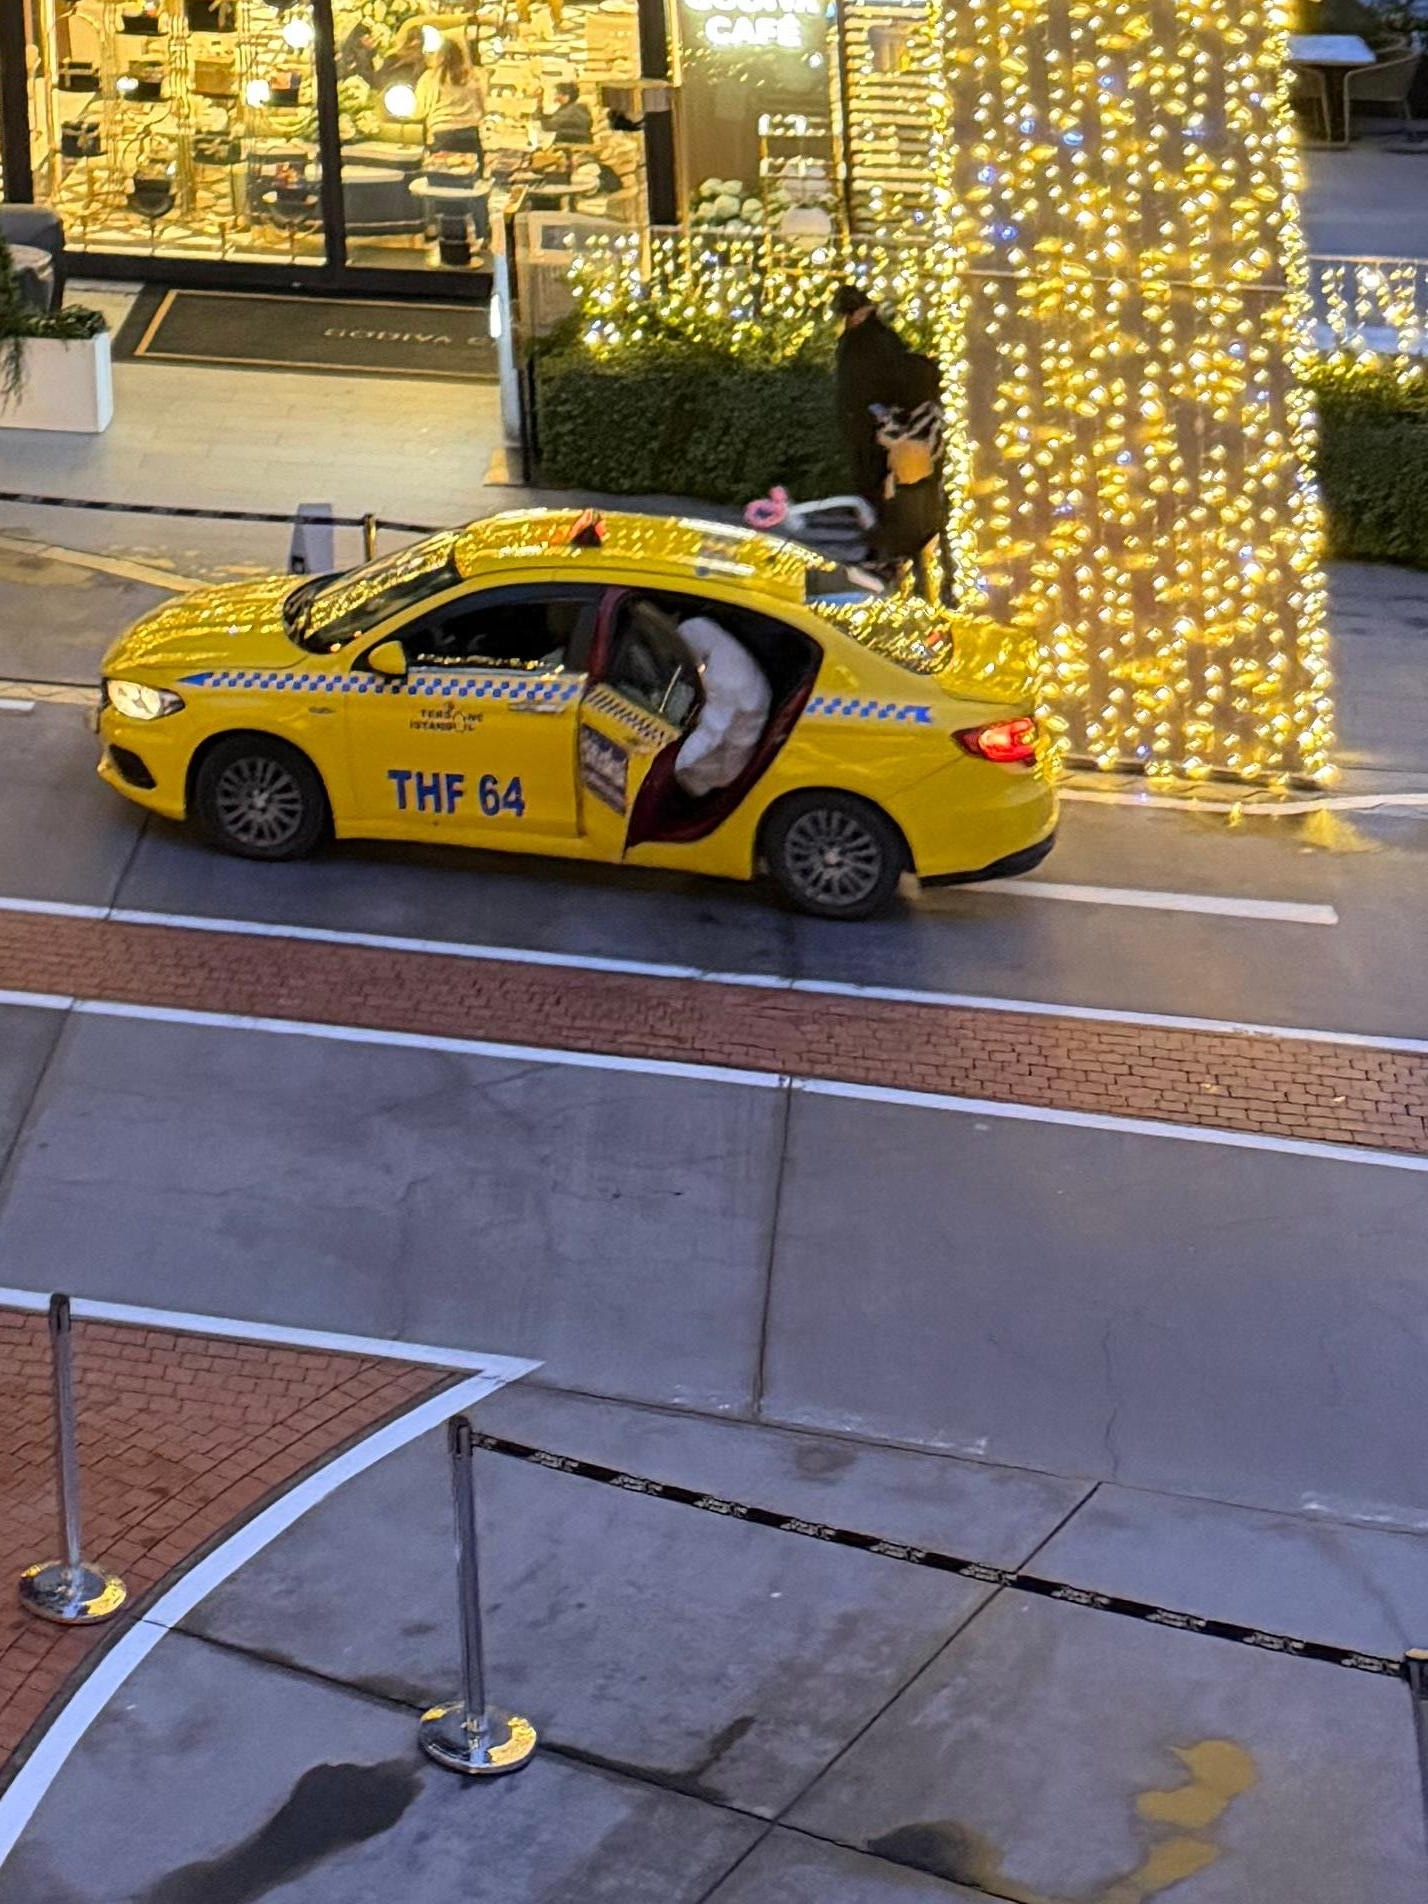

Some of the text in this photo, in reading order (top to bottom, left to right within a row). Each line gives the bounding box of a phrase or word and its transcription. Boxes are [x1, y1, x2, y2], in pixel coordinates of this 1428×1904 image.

[704, 13, 803, 49] CAFÉ
[387, 770, 526, 816] THF 64
